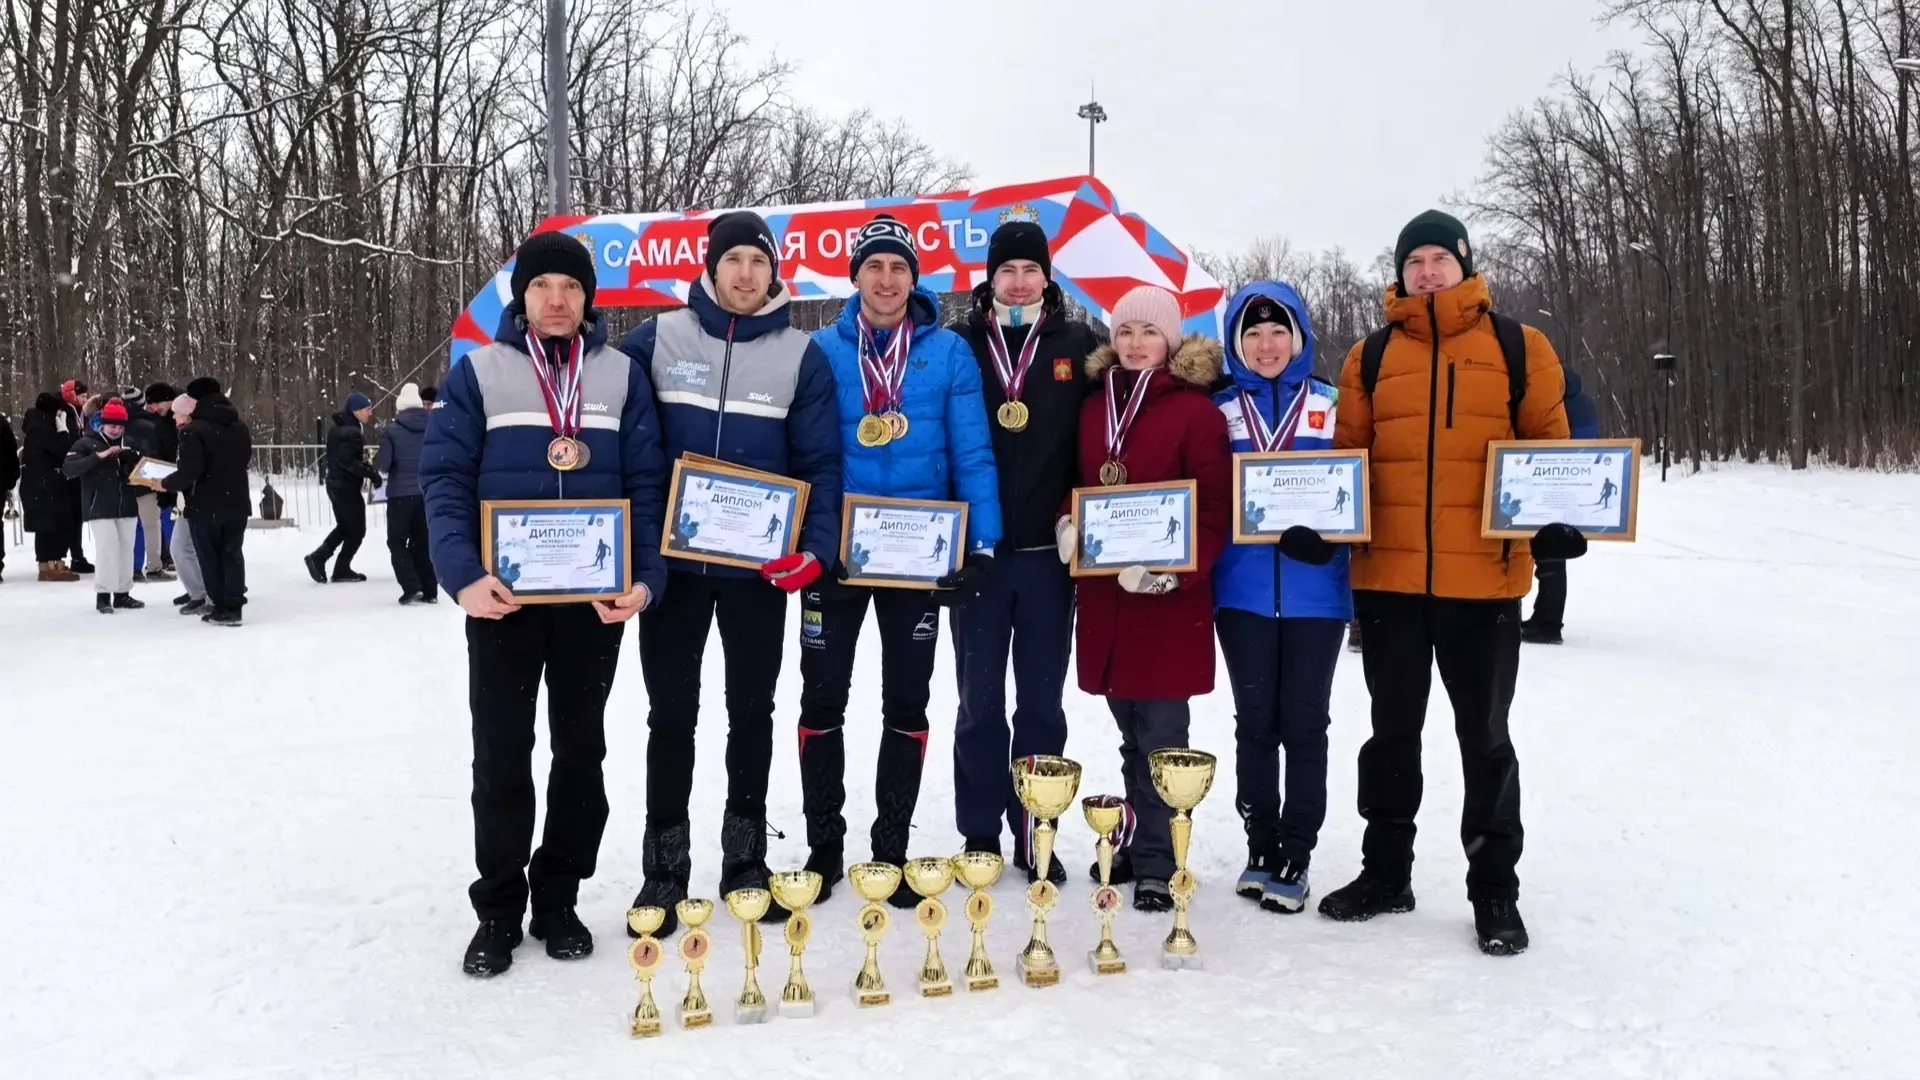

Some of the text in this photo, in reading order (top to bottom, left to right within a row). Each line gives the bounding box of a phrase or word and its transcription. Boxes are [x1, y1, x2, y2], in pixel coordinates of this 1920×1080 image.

[603, 231, 807, 267] САМАРЯ
[1531, 466, 1592, 477] ДИПЛОМ
[1272, 476, 1326, 488] ДИПЛОМ
[710, 493, 763, 511] ДИПЛОМ
[1110, 507, 1159, 520] ДИПЛОМ
[879, 520, 928, 532] ДИПЛОМ
[528, 528, 586, 540] ДИПЛОМ
